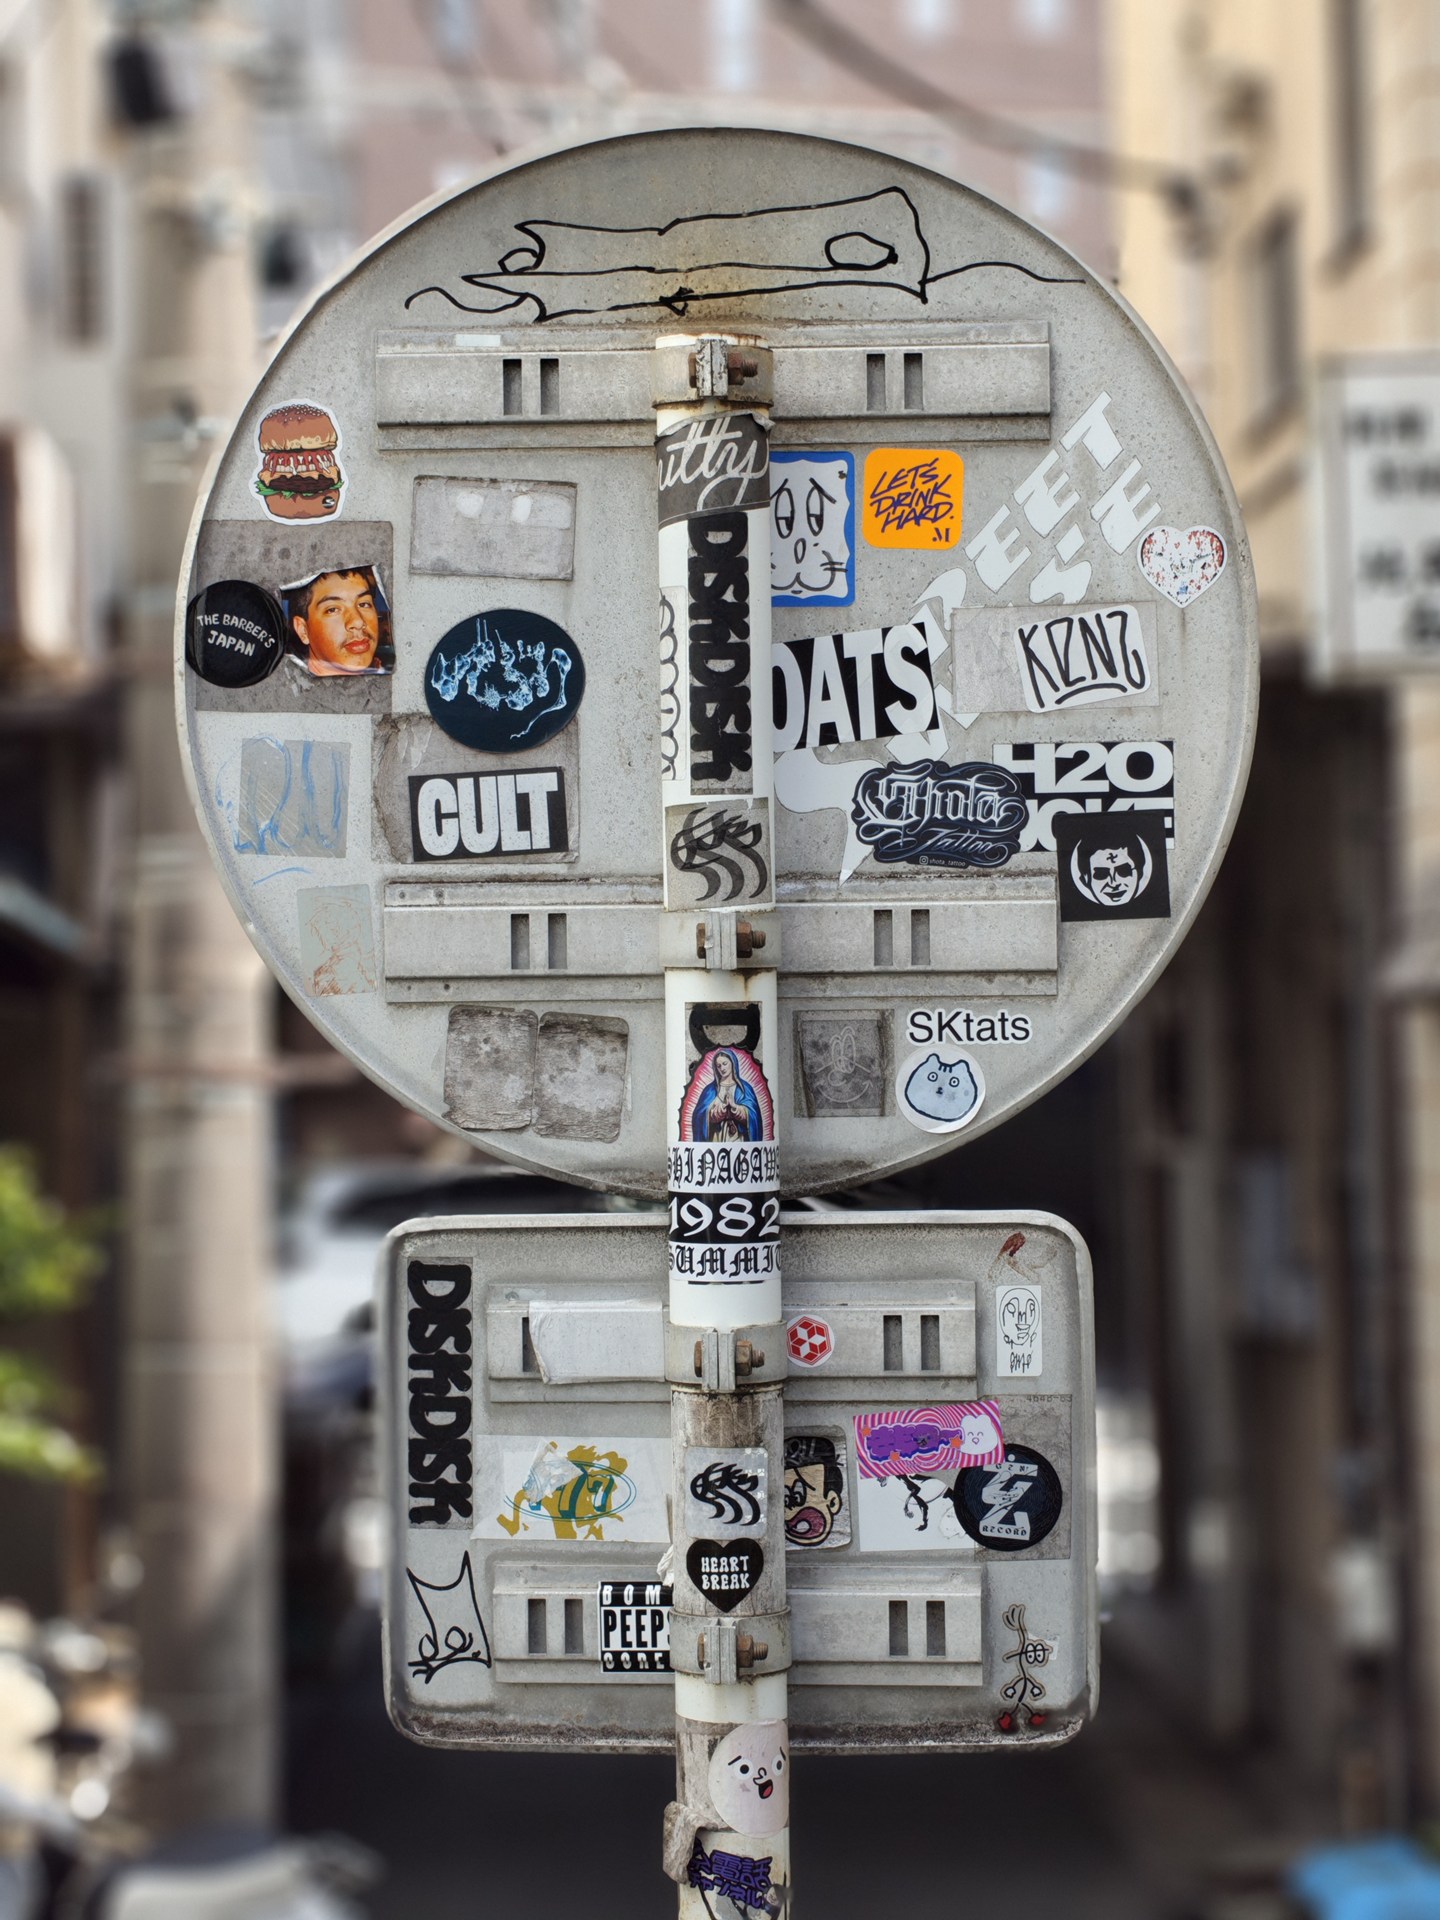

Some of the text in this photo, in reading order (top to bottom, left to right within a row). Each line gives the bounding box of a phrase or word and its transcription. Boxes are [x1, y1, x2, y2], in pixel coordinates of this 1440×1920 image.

[870, 474, 951, 518] DRINK
[197, 614, 275, 648] THE BARBER'S
[208, 630, 255, 656] JAPAN
[417, 772, 558, 856] CULT
[909, 1011, 1030, 1043] SKtats
[668, 1197, 780, 1237] 1982
[701, 1555, 749, 1573] HEART
[702, 1573, 750, 1590] BREAK
[603, 1609, 670, 1648] PEEP
